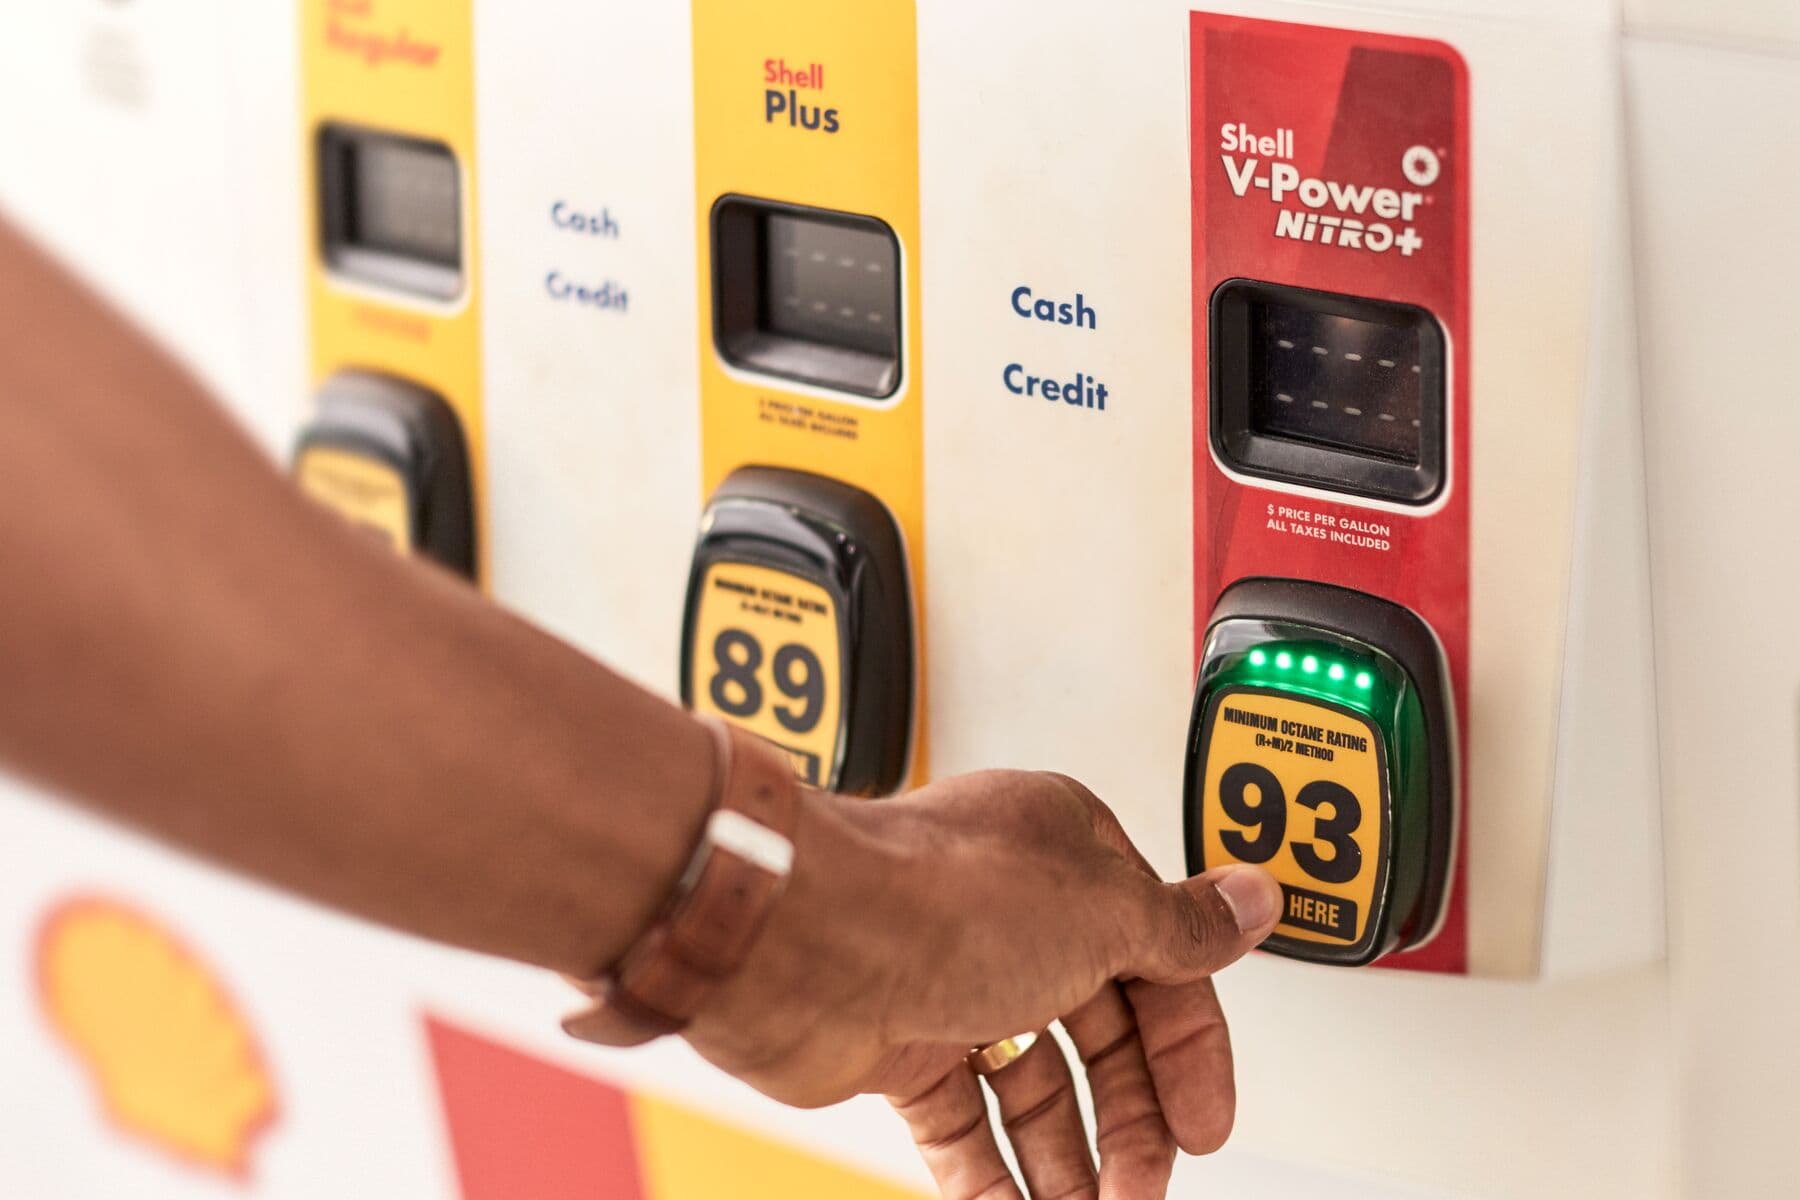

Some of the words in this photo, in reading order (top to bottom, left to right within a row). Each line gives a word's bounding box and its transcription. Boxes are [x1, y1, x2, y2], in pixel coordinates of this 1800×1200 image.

[764, 58, 823, 90] Shell
[766, 88, 840, 134] Plus
[1220, 122, 1294, 159] Shell
[1220, 154, 1423, 221] V-Power
[551, 200, 619, 240] Cash
[545, 271, 628, 314] Credit
[1011, 286, 1096, 330] Cash
[1003, 362, 1108, 411] Credit
[1266, 518, 1288, 532] ALL
[1290, 522, 1327, 540] TAXES
[1330, 530, 1390, 551] INCLUDED
[1267, 503, 1274, 516] $
[1278, 506, 1311, 522] PRICE
[1314, 513, 1336, 528] PER
[1339, 518, 1390, 537] GALLON
[709, 627, 825, 734] 89
[1223, 706, 1278, 733] MINIMUM
[1281, 719, 1324, 743] OCTANE
[1326, 729, 1368, 753] RATING
[1255, 733, 1294, 754] (R+M)/2
[1295, 742, 1334, 762] METHOD
[1218, 761, 1362, 885] 93
[1289, 893, 1340, 929] HERE
